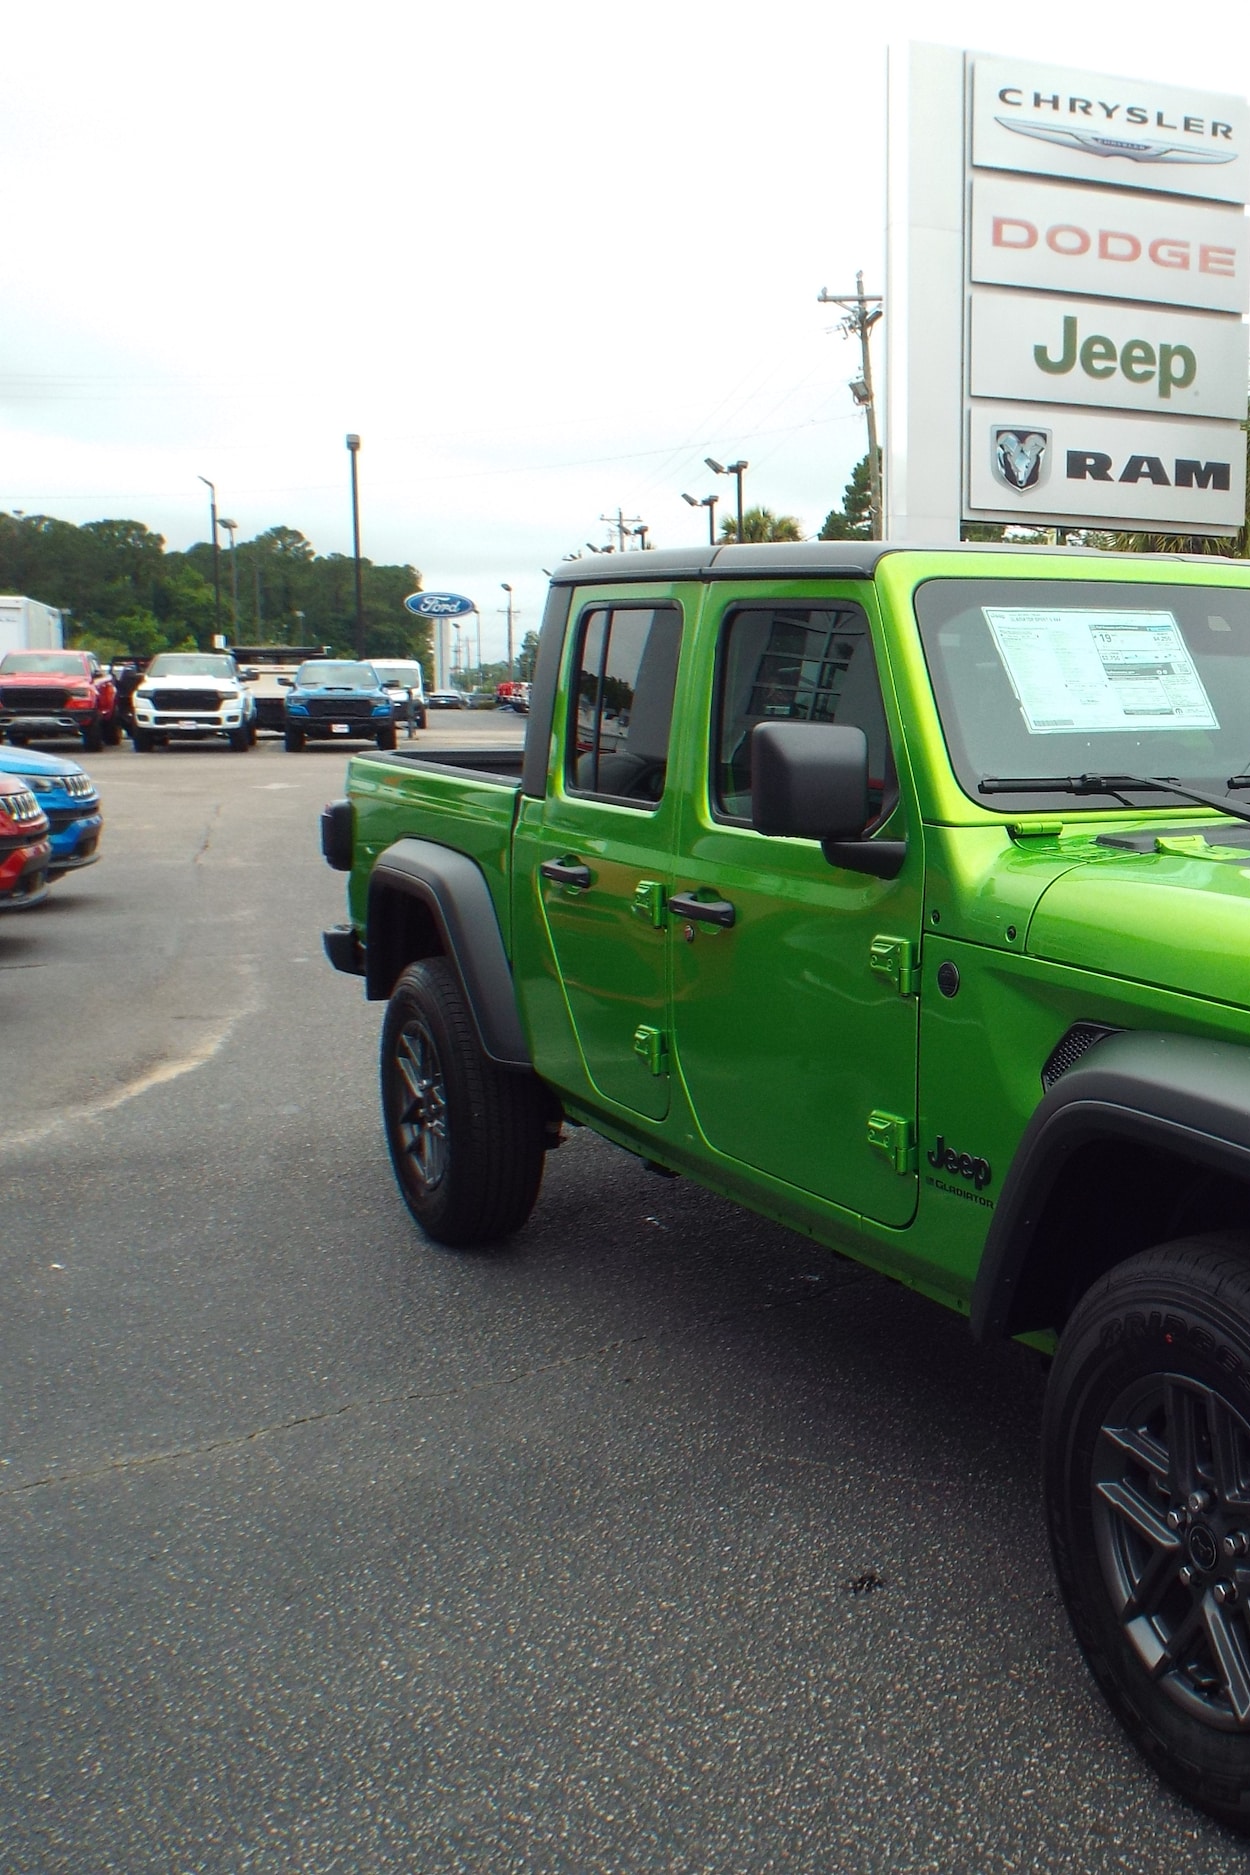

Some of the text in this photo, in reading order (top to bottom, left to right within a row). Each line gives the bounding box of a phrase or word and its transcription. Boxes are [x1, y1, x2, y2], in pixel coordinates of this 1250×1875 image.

[998, 87, 1234, 140] CHRYSLER
[991, 216, 1237, 277] DODGE
[1033, 314, 1197, 399] Jeep
[1066, 449, 1231, 491] RAM
[420, 595, 461, 612] Ford
[1099, 633, 1112, 643] 19
[927, 1134, 992, 1191] Jeep
[935, 1180, 995, 1210] GLADIATOR
